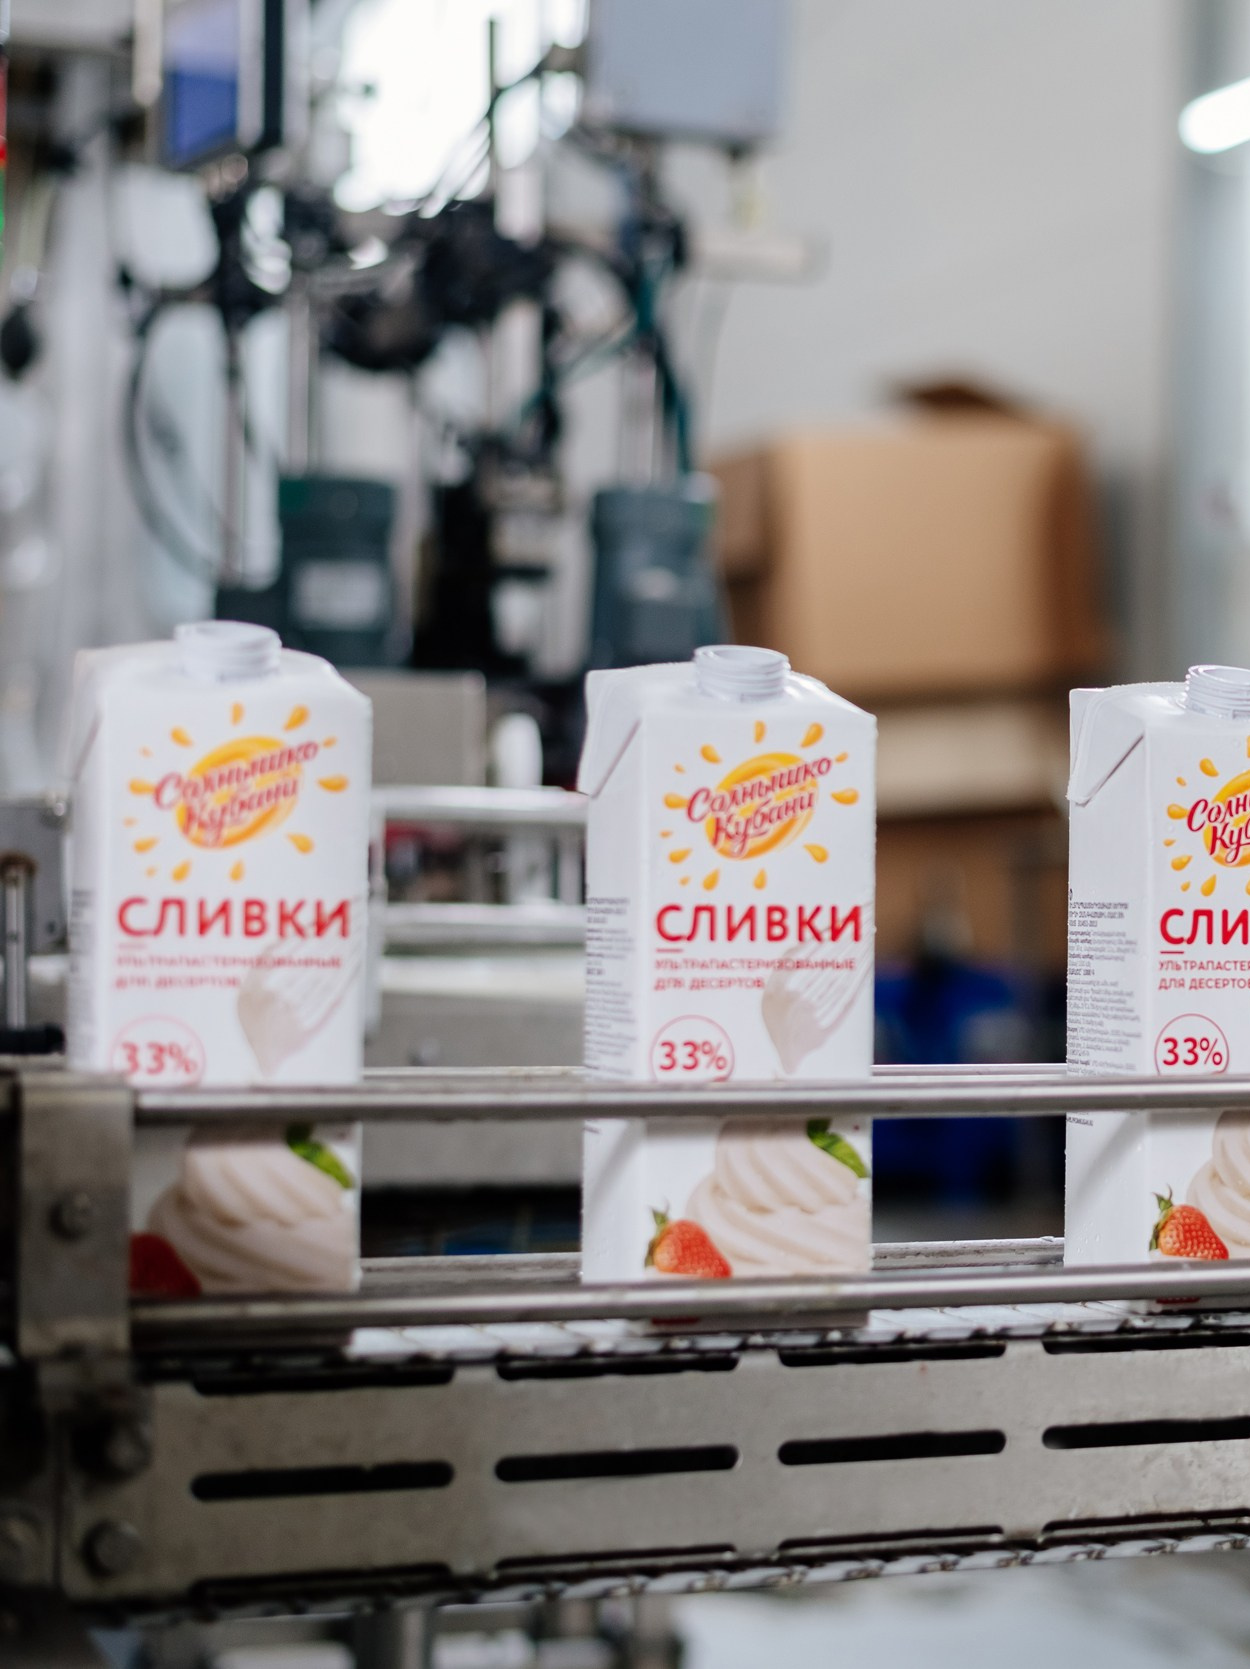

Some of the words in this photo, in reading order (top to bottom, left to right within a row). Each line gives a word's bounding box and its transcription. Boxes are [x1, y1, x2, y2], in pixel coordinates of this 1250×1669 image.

[153, 741, 319, 811] Солнышко
[686, 756, 832, 824] Солнышко
[181, 778, 301, 848] Кубани
[711, 790, 815, 857] Кубани
[117, 897, 350, 938] СЛИВКИ
[655, 904, 861, 942] СЛИВКИ
[655, 958, 856, 972] УЛЬТРАПАСТЕРИЗОВАННЫЕ
[654, 977, 685, 992] ДЛЯ
[690, 977, 765, 991] ДЕСЕРТОВ
[1157, 977, 1187, 992] ДЛЯ
[122, 1041, 198, 1075] 33%
[660, 1040, 727, 1071] 33%
[1163, 1037, 1223, 1066] 33%
